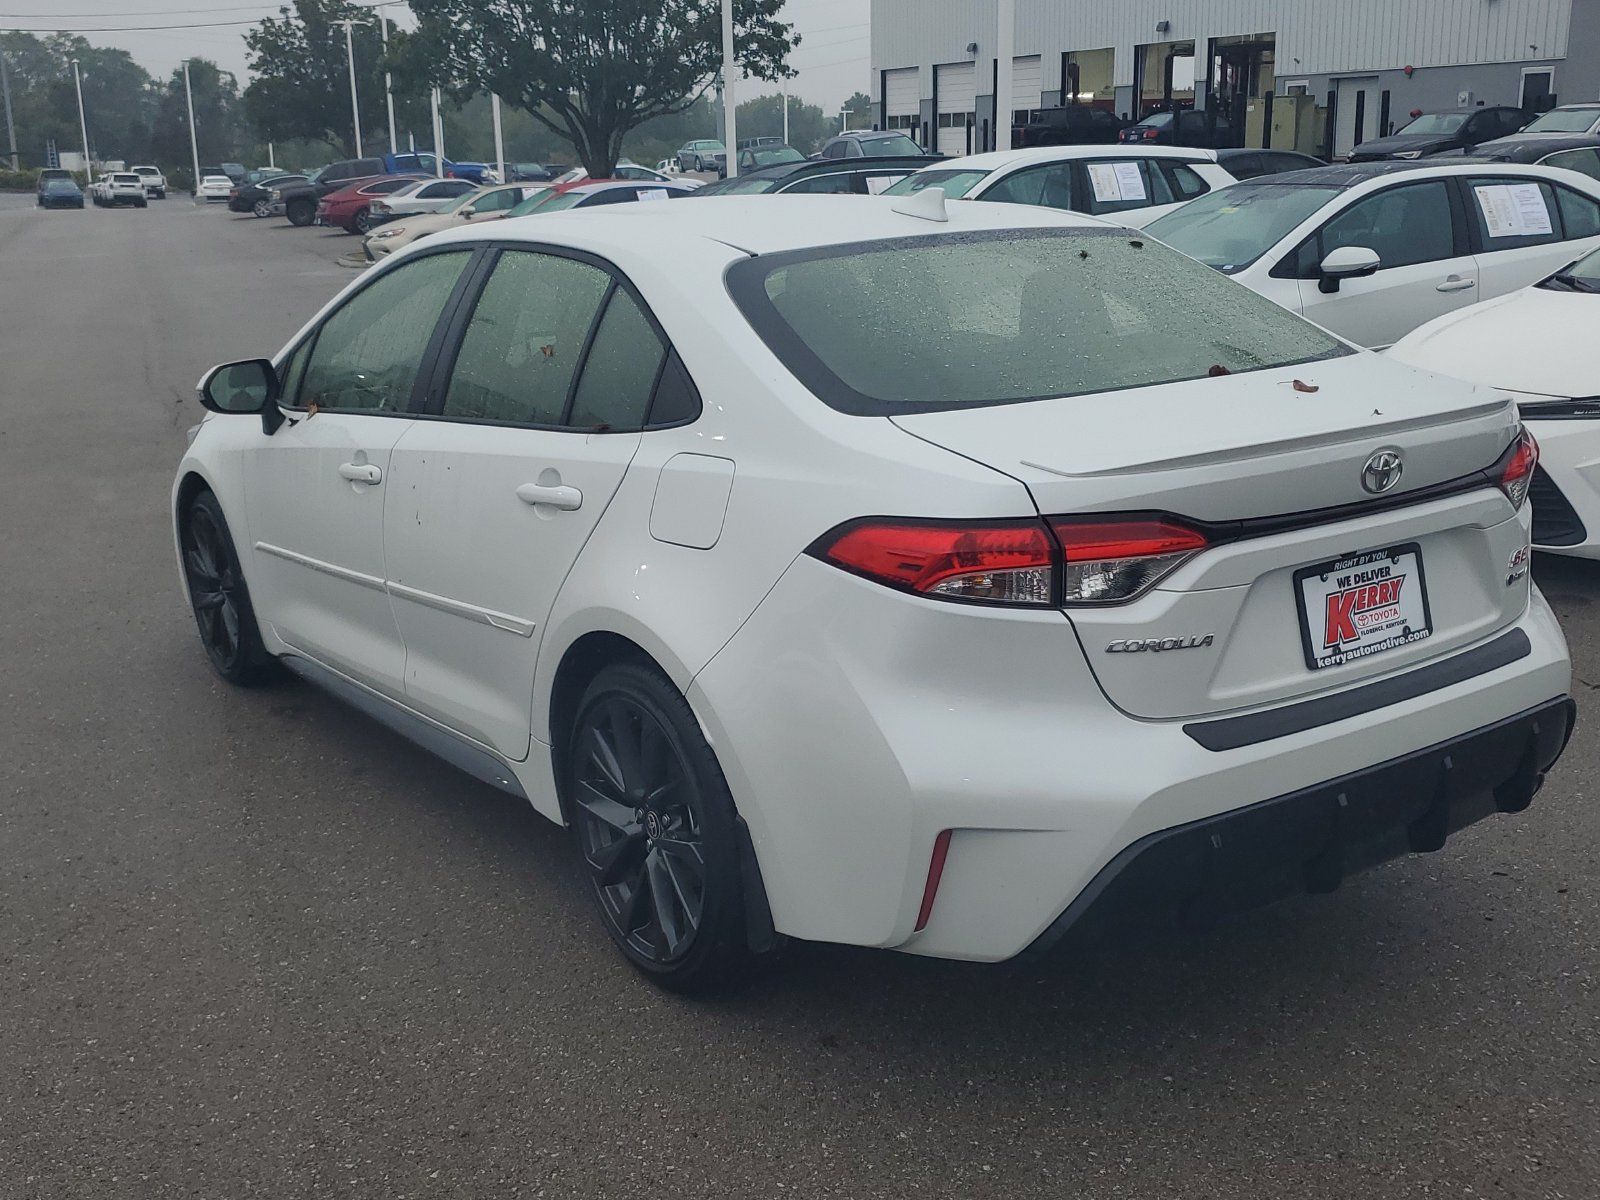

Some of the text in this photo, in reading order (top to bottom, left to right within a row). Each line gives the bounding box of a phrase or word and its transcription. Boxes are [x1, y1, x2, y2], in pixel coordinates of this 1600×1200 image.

[1334, 551, 1388, 571] RIGHT BY YOU
[1337, 566, 1391, 589] WE DELIVER
[1324, 575, 1405, 649] KERRY
[1369, 608, 1399, 623] TOYOTA
[1104, 633, 1215, 653] COROLLA
[1317, 629, 1430, 668] kerryautomotive.com
